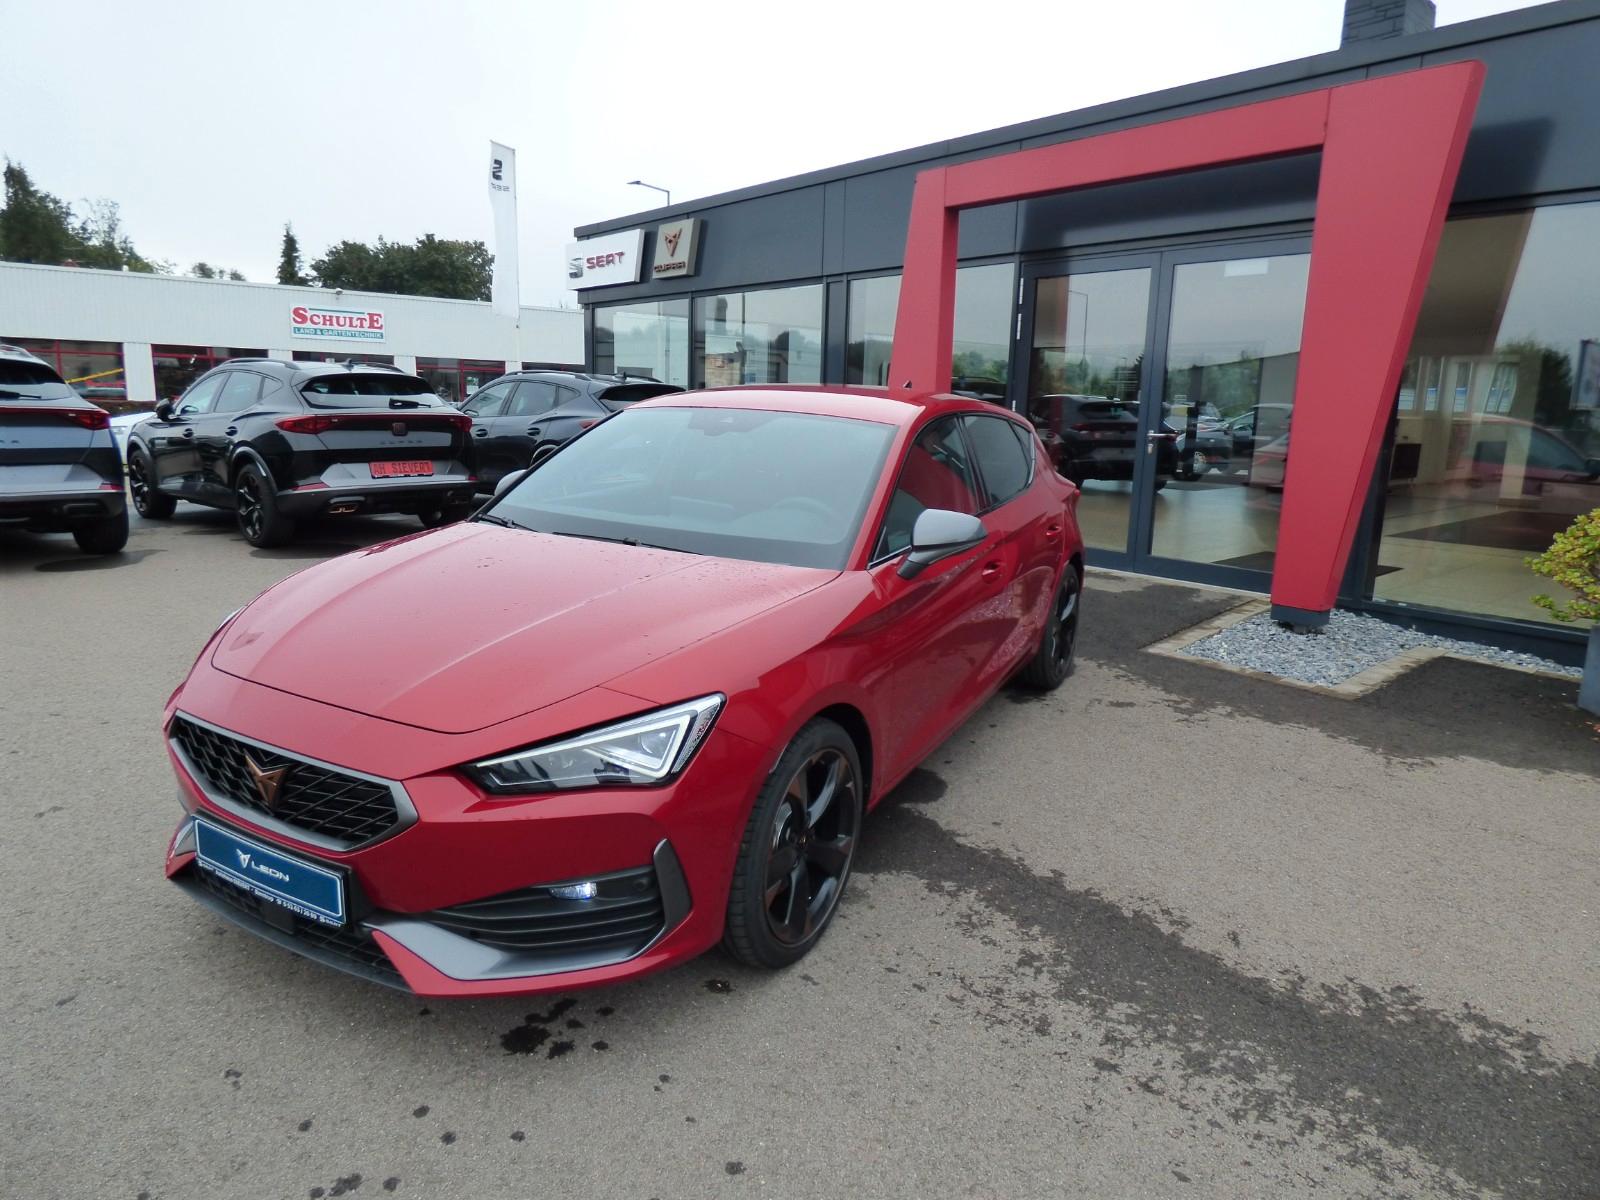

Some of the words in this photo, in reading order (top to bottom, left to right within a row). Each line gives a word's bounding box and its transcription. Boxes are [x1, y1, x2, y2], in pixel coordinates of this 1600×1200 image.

[586, 251, 625, 270] SEAT
[292, 306, 384, 330] SCHULTE
[295, 327, 315, 335] LAND
[323, 329, 382, 339] GARTENTECHNIK
[391, 461, 431, 474] SIEVERT
[251, 860, 290, 882] LEON
